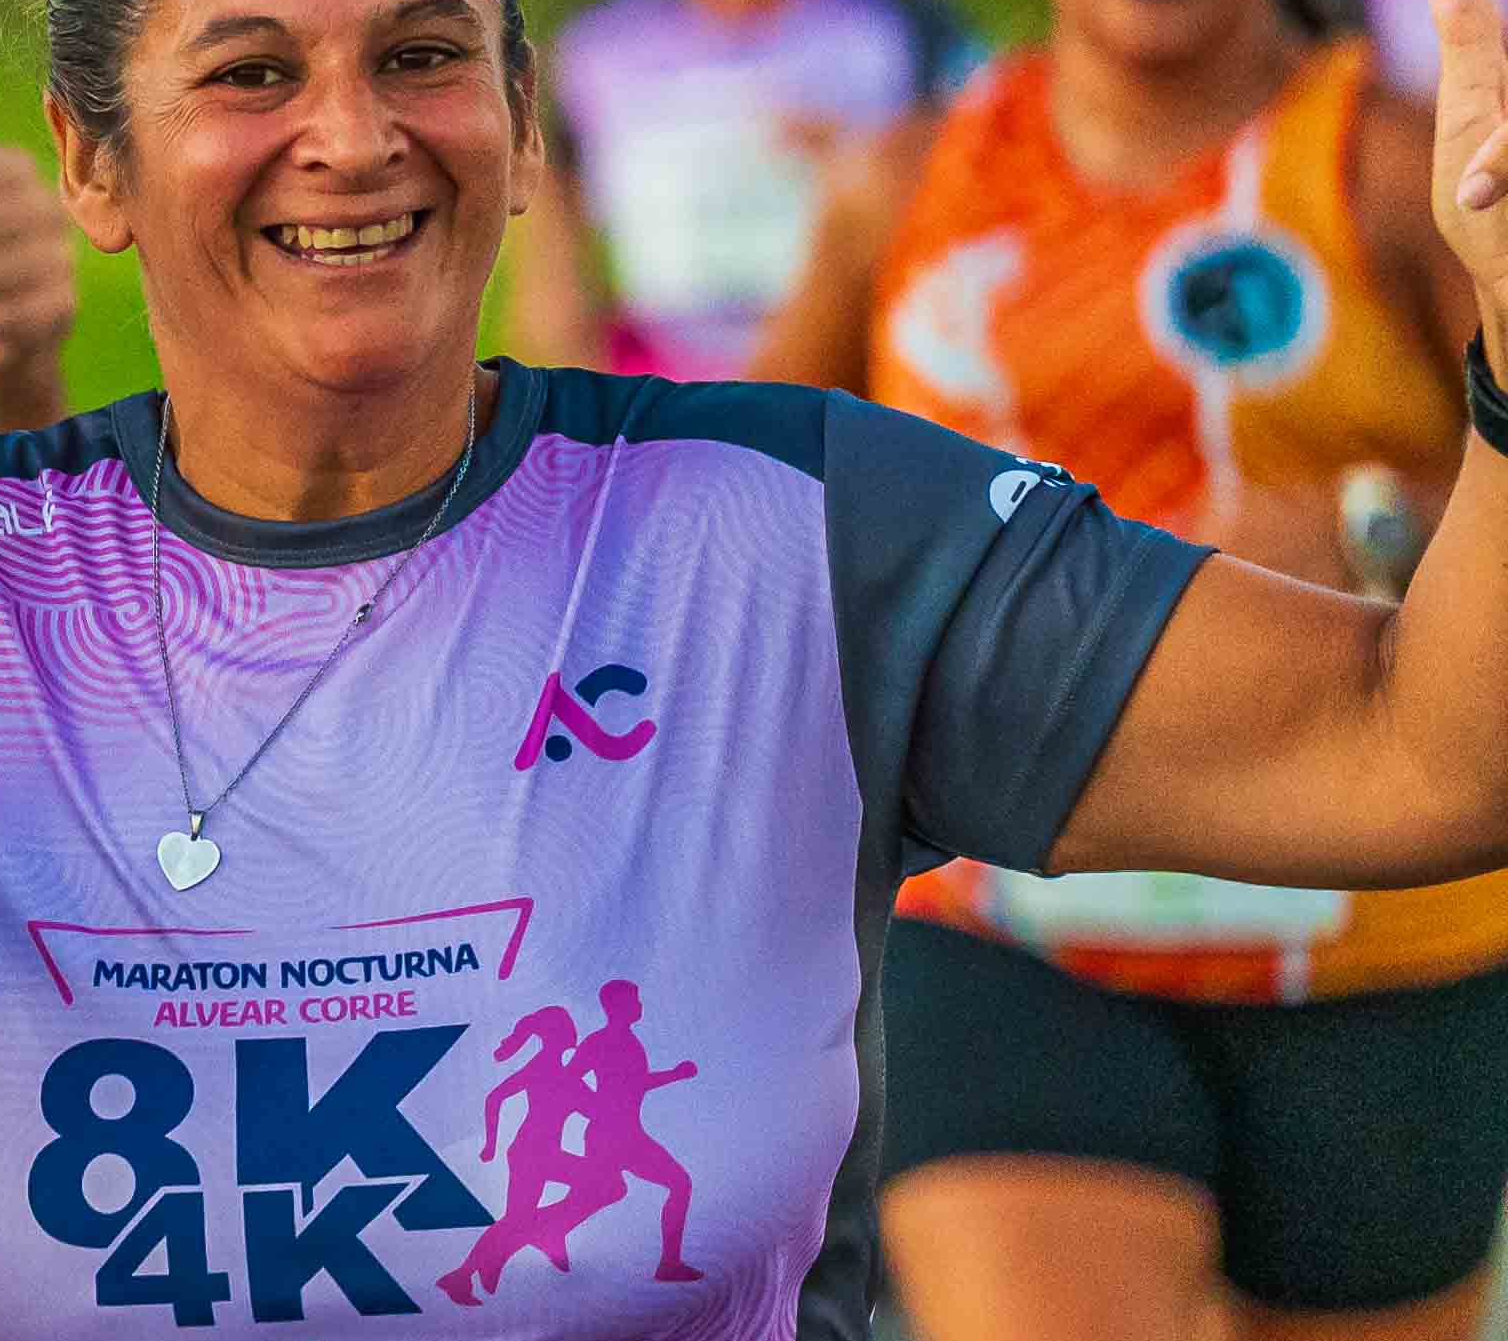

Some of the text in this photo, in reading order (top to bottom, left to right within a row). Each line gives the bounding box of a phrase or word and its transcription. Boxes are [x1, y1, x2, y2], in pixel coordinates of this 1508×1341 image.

[92, 942, 480, 993] MARATON NOCTURNA
[153, 989, 418, 1029] ALVEAR CORRE
[27, 1023, 497, 1249] 8K
[95, 1182, 423, 1328] 4K
